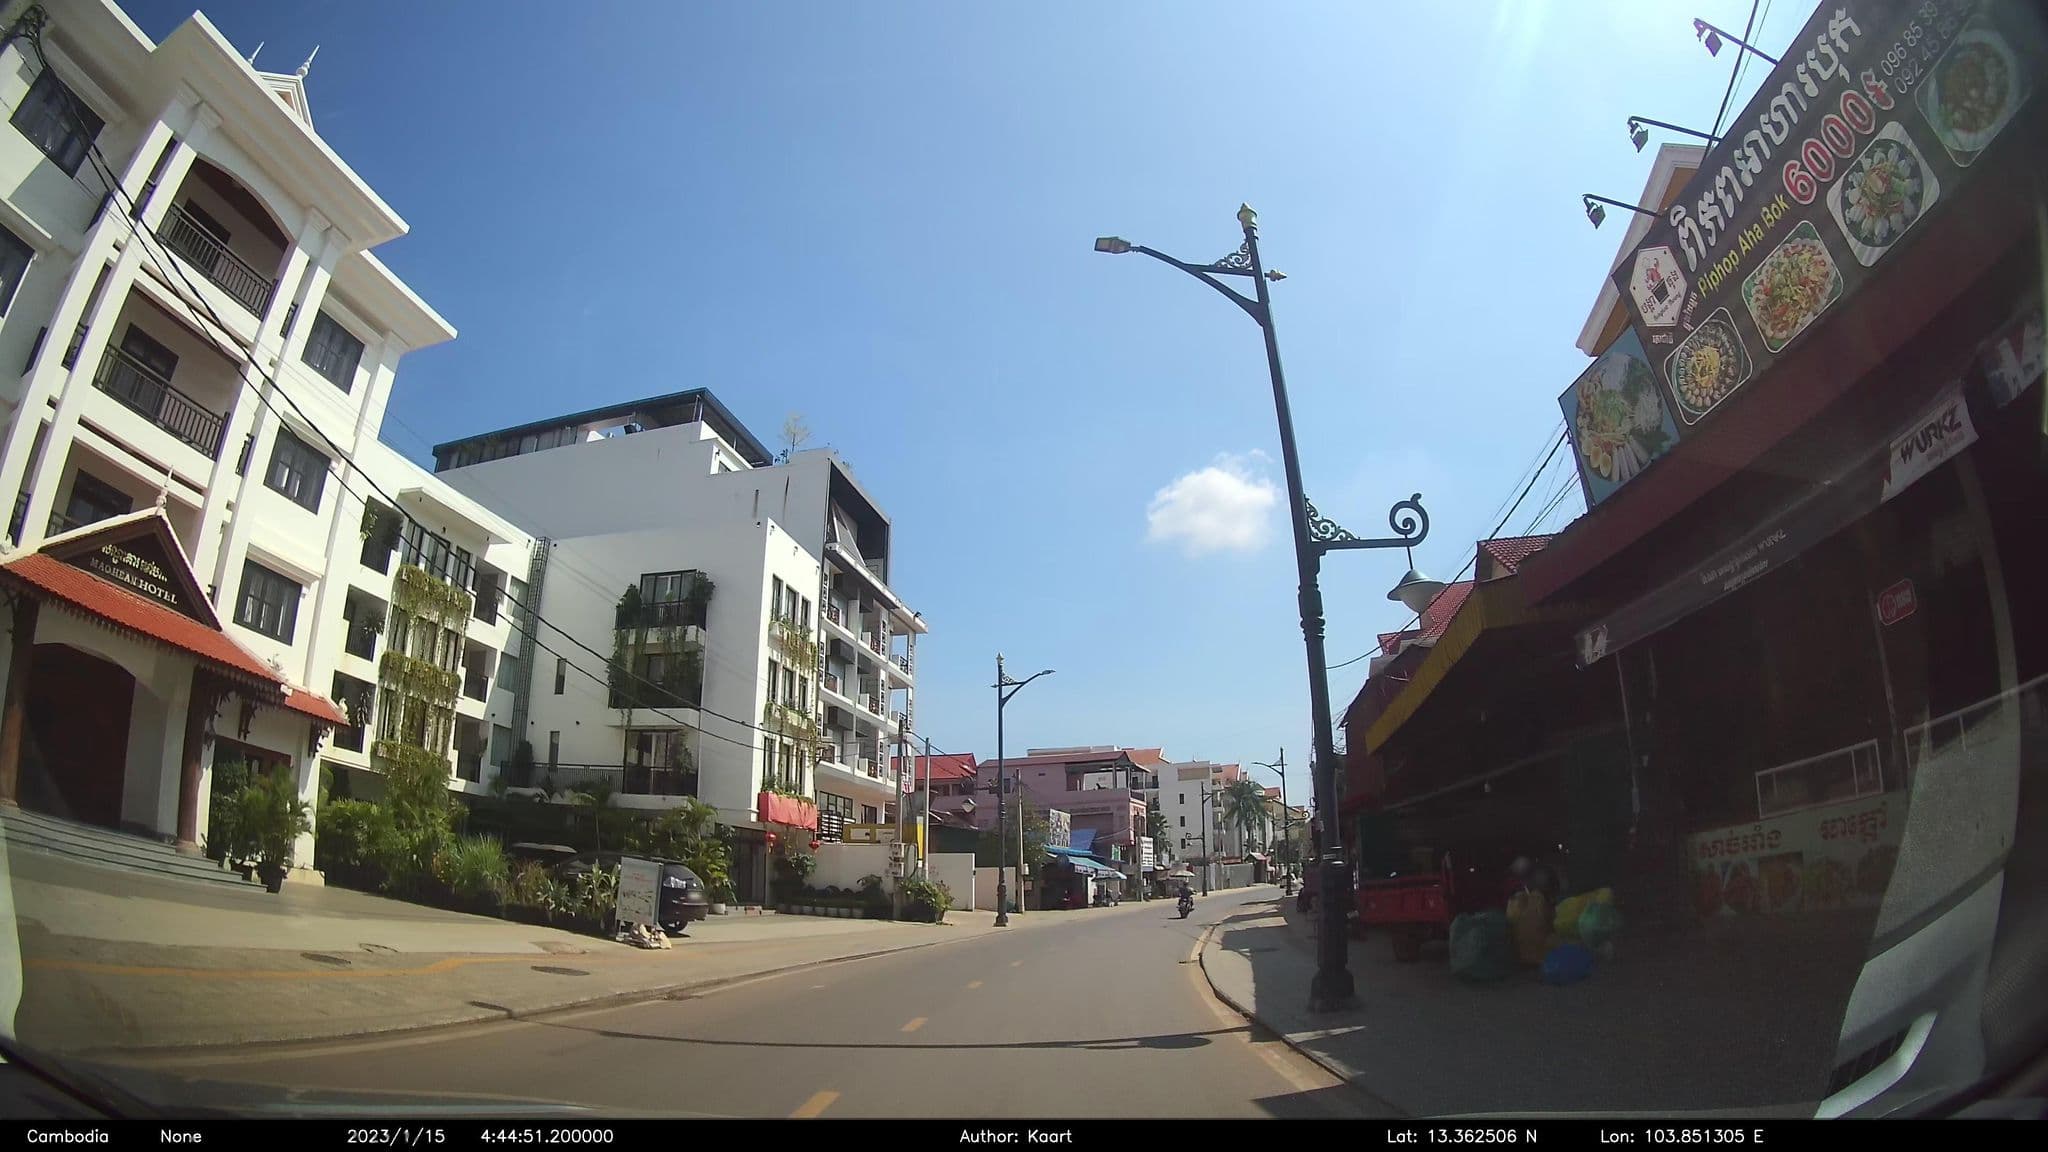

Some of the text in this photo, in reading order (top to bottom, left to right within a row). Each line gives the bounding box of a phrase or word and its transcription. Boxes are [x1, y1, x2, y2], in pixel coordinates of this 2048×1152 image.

[1880, 42, 1907, 76] 096
[1903, 20, 1923, 47] 85
[1894, 57, 1924, 94] 092
[1698, 193, 1790, 298] Piphop Aha Bok
[1900, 405, 1962, 464] WURKZ
[138, 579, 178, 605] HOTEL
